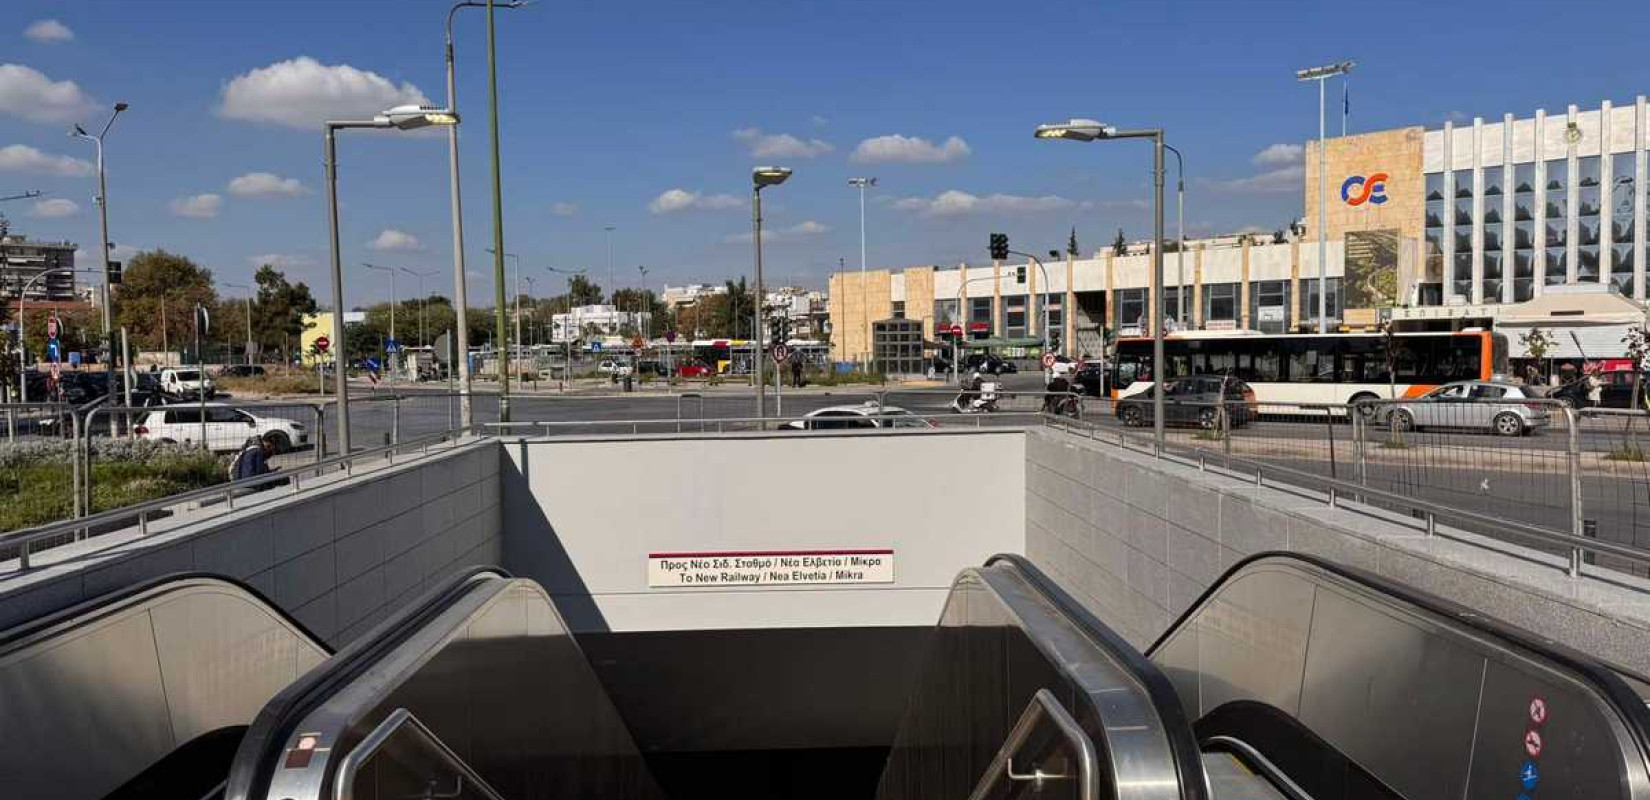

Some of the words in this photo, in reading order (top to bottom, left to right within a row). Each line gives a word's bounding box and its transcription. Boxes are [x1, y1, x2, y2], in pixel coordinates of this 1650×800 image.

[661, 560, 688, 571] Προς
[691, 559, 710, 569] Νέο
[713, 559, 731, 569] Σιδ.
[735, 558, 771, 570] Σταθμό
[774, 558, 778, 567] /
[780, 557, 799, 567] Νέα
[803, 556, 841, 568] Ελβετία
[844, 556, 848, 566] /
[680, 573, 693, 583] To
[696, 572, 718, 582] New
[721, 571, 760, 583] Railway
[763, 571, 767, 580] /
[770, 570, 789, 580] Nea
[793, 570, 827, 580] Elvetia
[829, 570, 833, 580] /
[835, 570, 863, 580] Mikra
